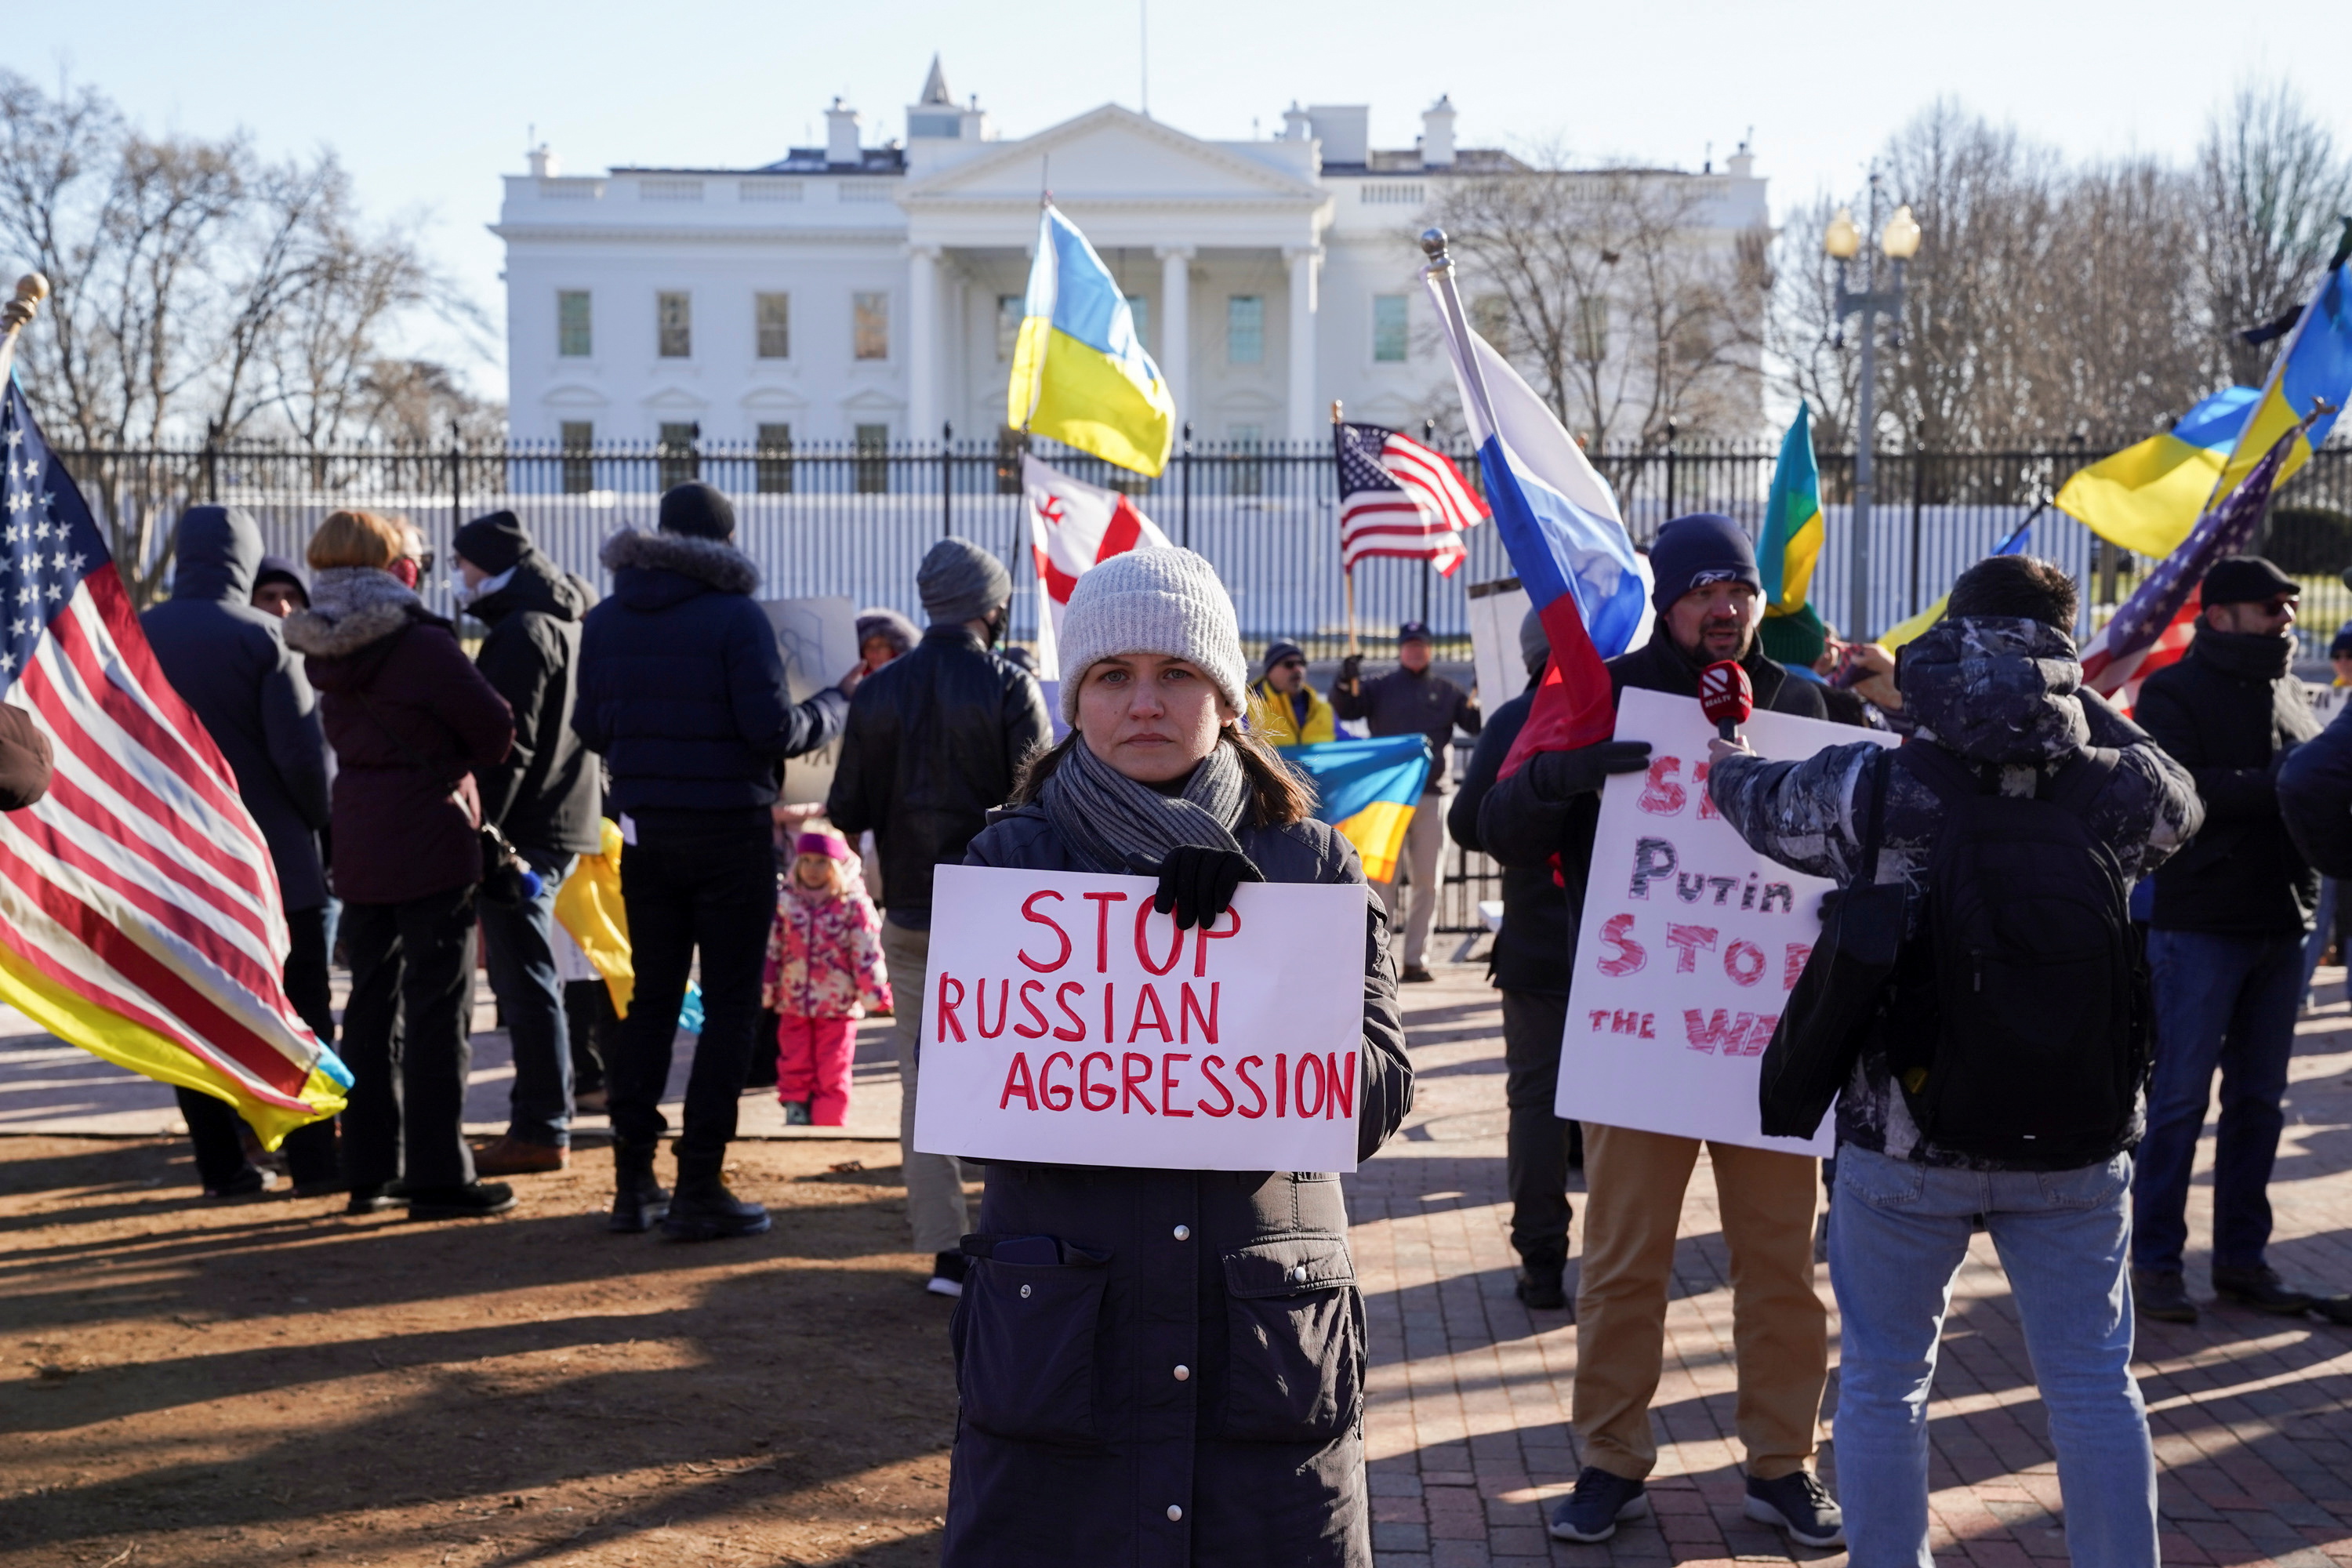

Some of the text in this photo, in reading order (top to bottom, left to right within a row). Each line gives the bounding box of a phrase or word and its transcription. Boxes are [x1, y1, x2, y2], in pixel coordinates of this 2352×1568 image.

[1017, 890, 1242, 978] STOP
[938, 972, 1220, 1043] RUSSIAN
[1588, 1008, 1780, 1056] THE WA
[1000, 1051, 1356, 1120] AGGRESSION
